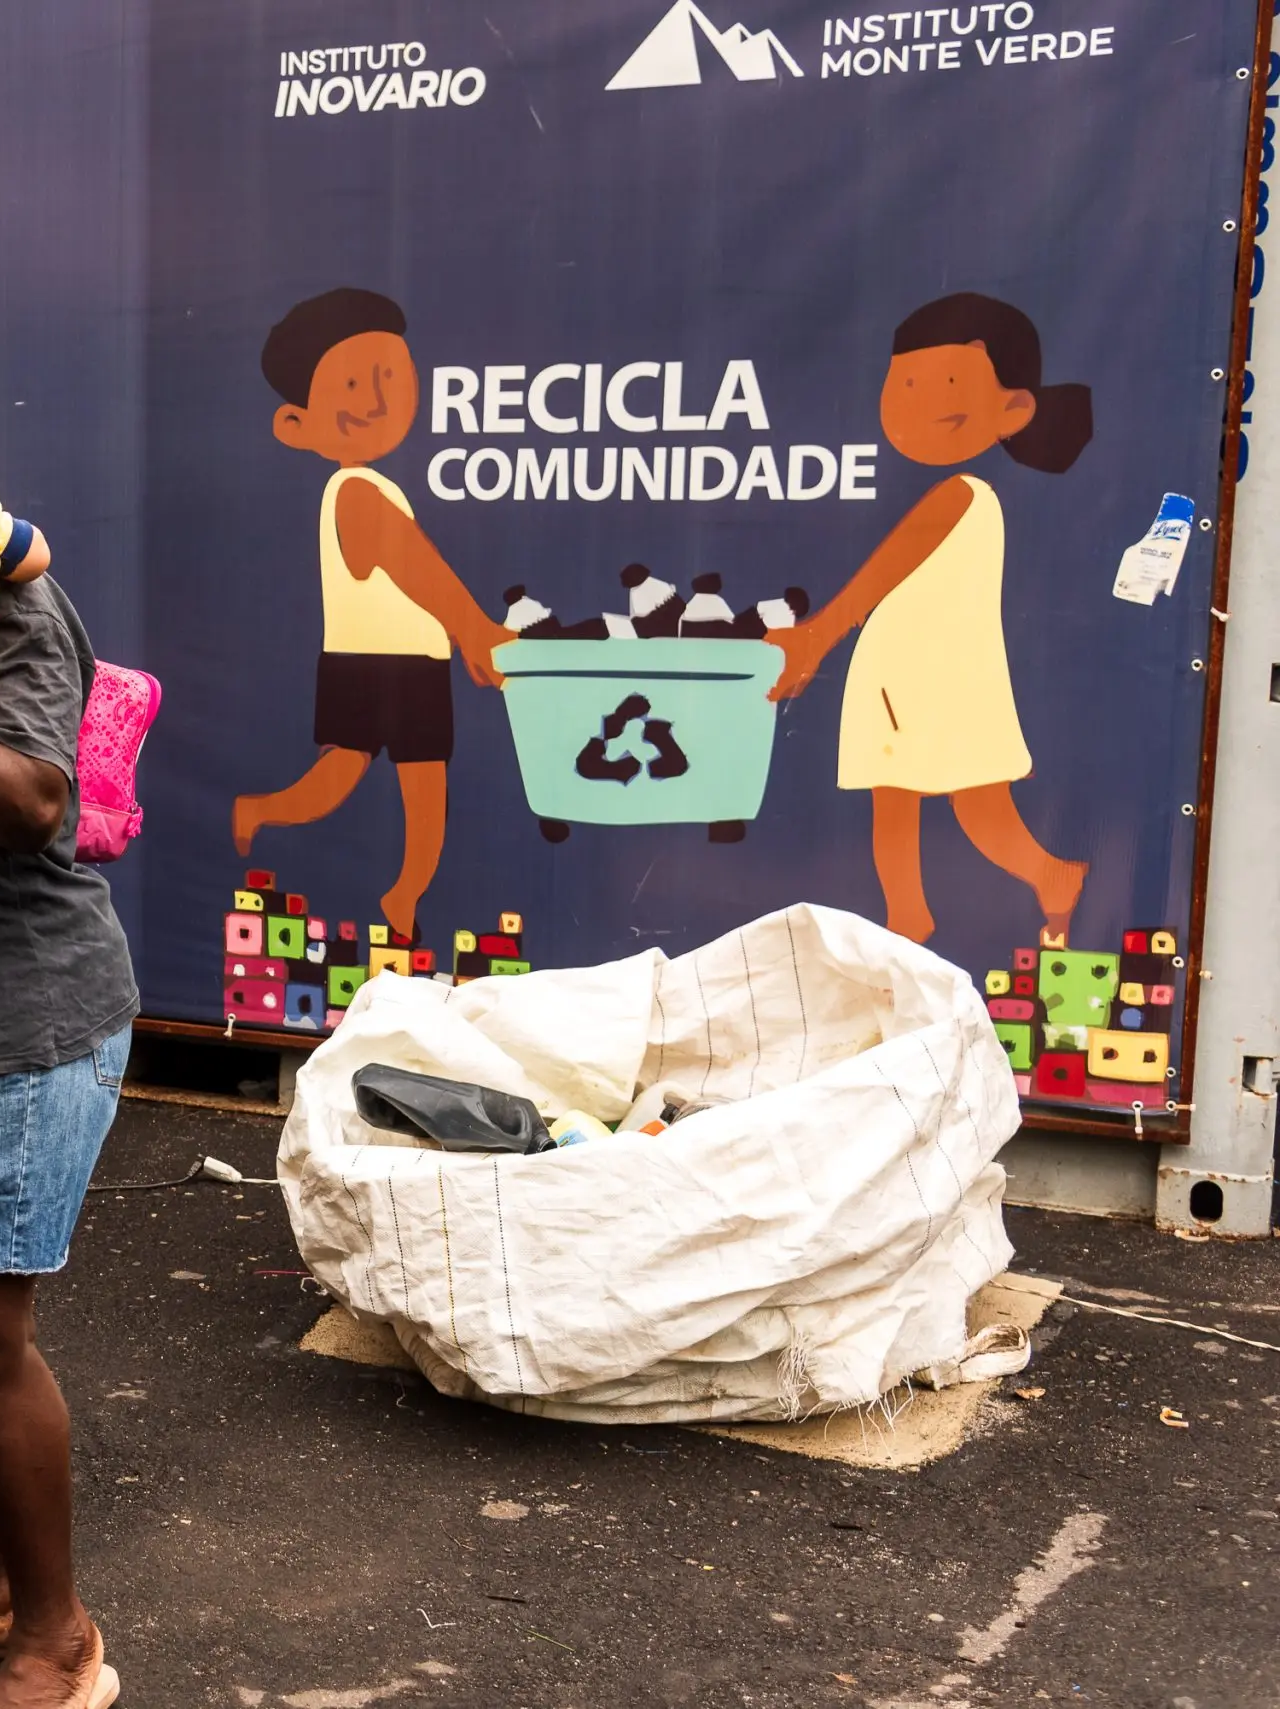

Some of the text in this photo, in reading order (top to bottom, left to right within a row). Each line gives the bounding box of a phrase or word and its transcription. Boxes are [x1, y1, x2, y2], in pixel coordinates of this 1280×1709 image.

[823, 1, 1035, 46] INSTITUTO
[280, 41, 426, 76] INSTITUTO
[821, 26, 1115, 79] MONTE VERDE
[274, 67, 487, 118] INOVARIO
[431, 359, 770, 434] RECICLA
[427, 443, 878, 501] COMUNIDADE
